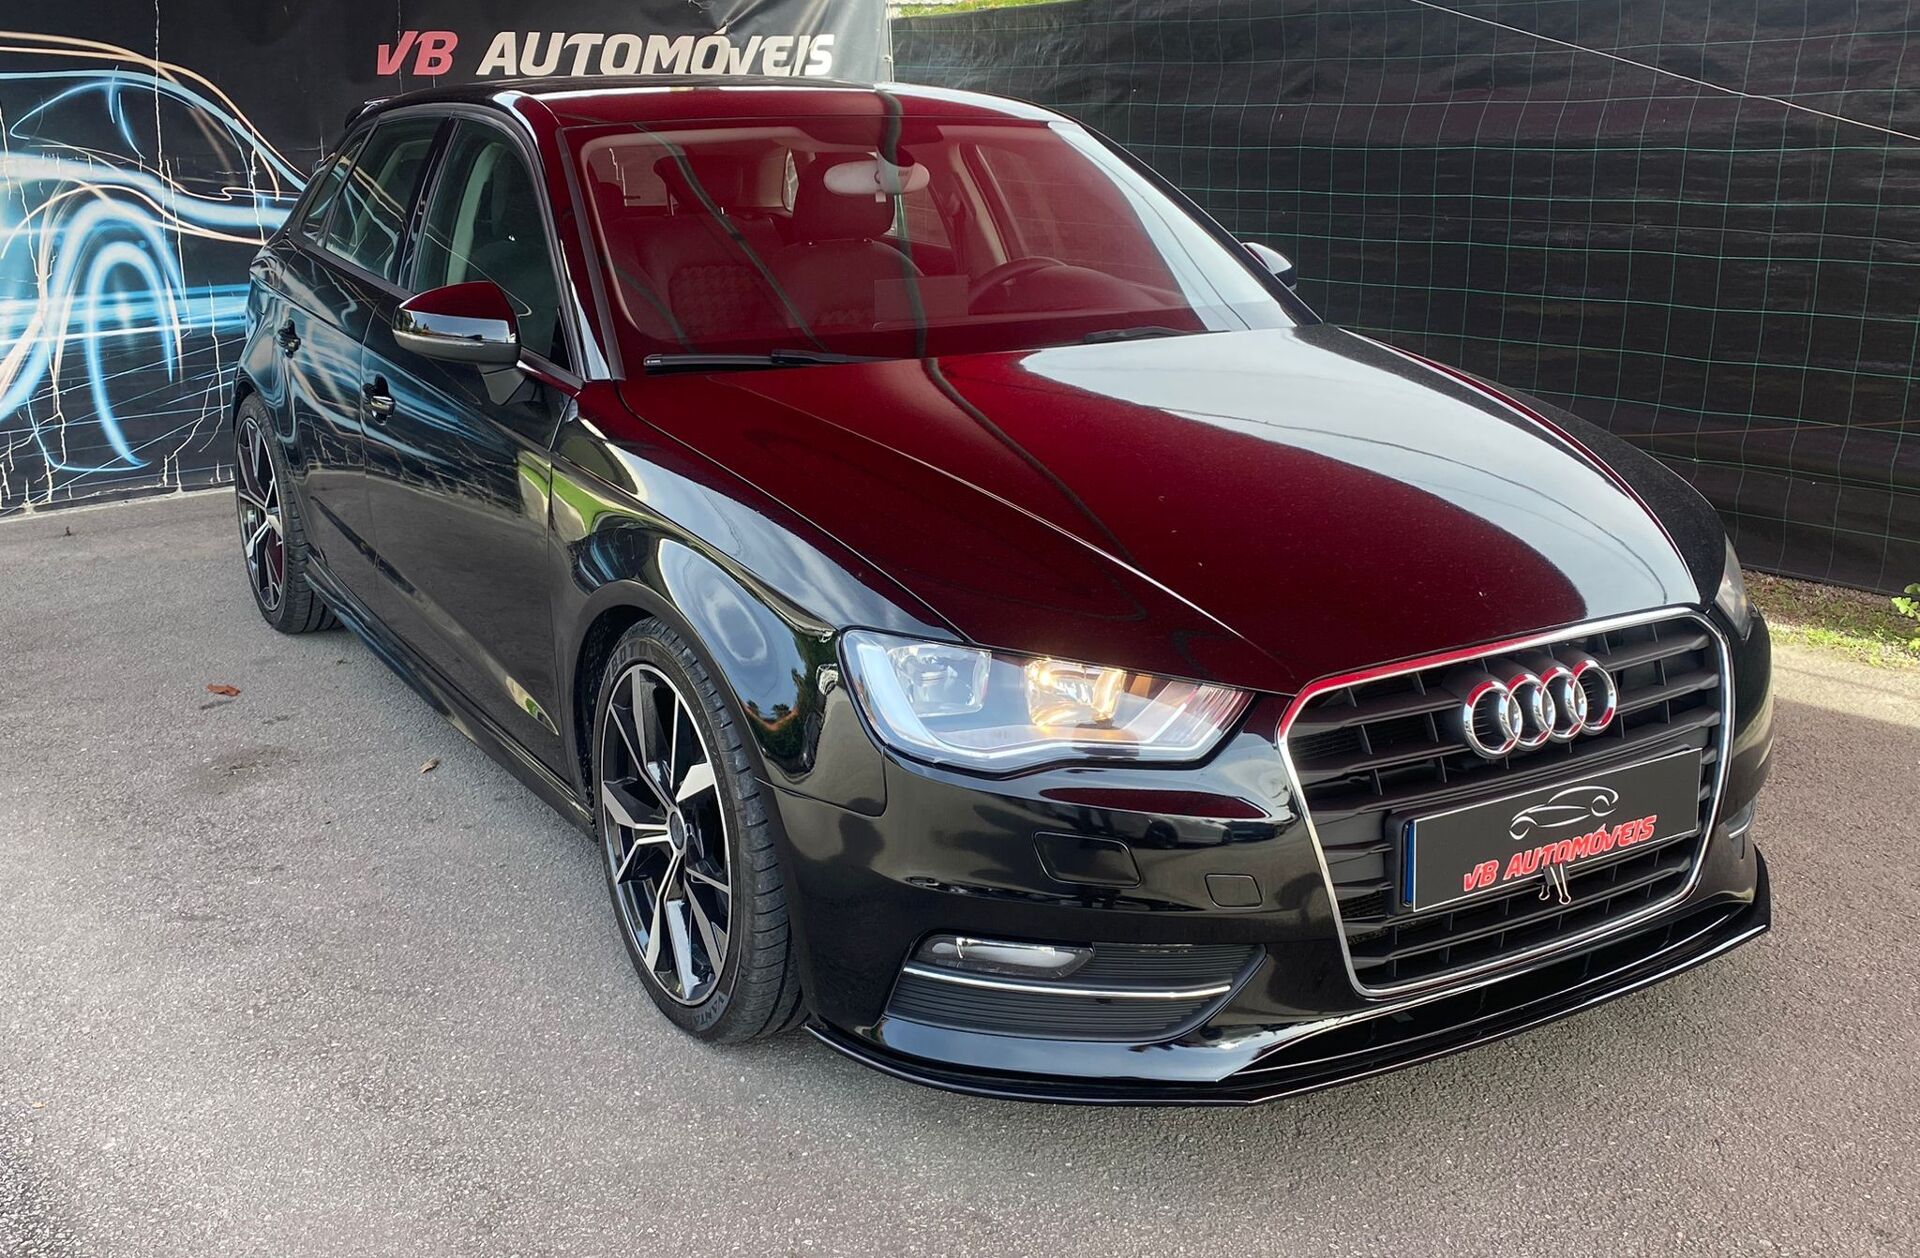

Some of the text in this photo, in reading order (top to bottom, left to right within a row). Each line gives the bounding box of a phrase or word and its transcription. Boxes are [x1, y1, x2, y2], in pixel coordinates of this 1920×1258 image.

[376, 26, 835, 77] VB AUTOMÓVEIS
[1463, 815, 1658, 891] VB AUTOMÓVEIS
